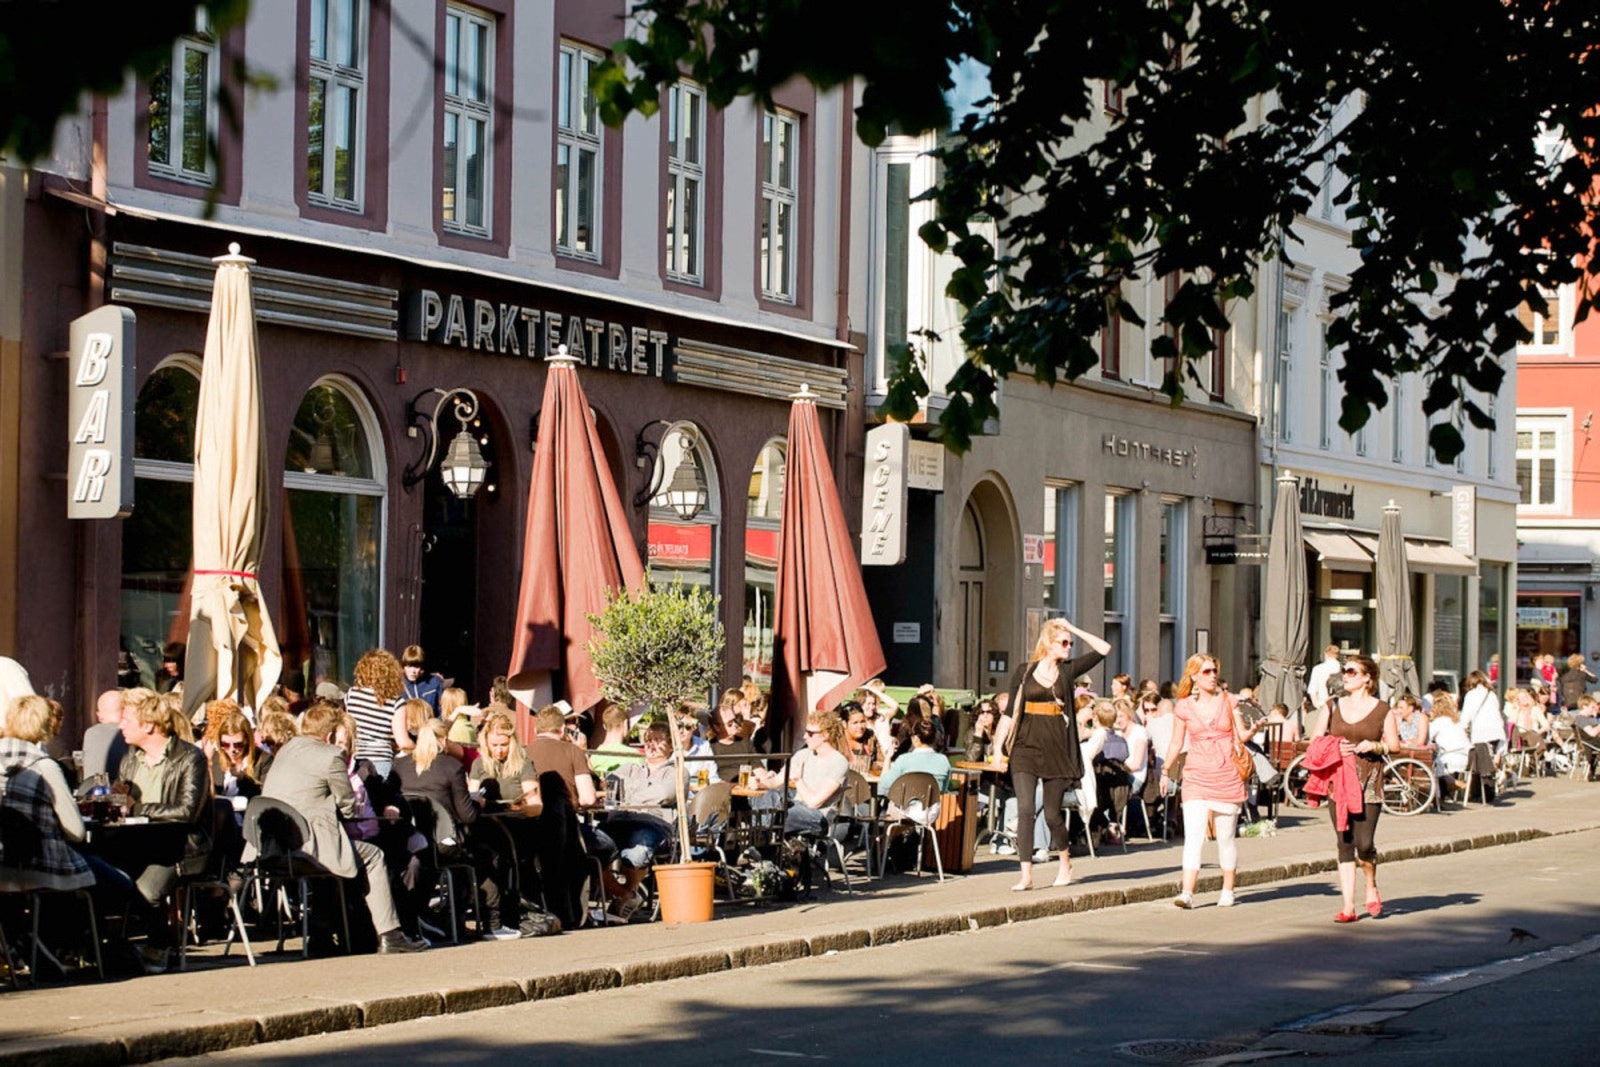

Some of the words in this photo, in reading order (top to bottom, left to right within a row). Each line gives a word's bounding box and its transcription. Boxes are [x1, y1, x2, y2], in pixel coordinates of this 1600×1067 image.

[420, 289, 668, 377] PARKTEATRET
[73, 332, 113, 503] BAR
[869, 440, 893, 556] SCENE
[1457, 490, 1470, 551] GRANIT
